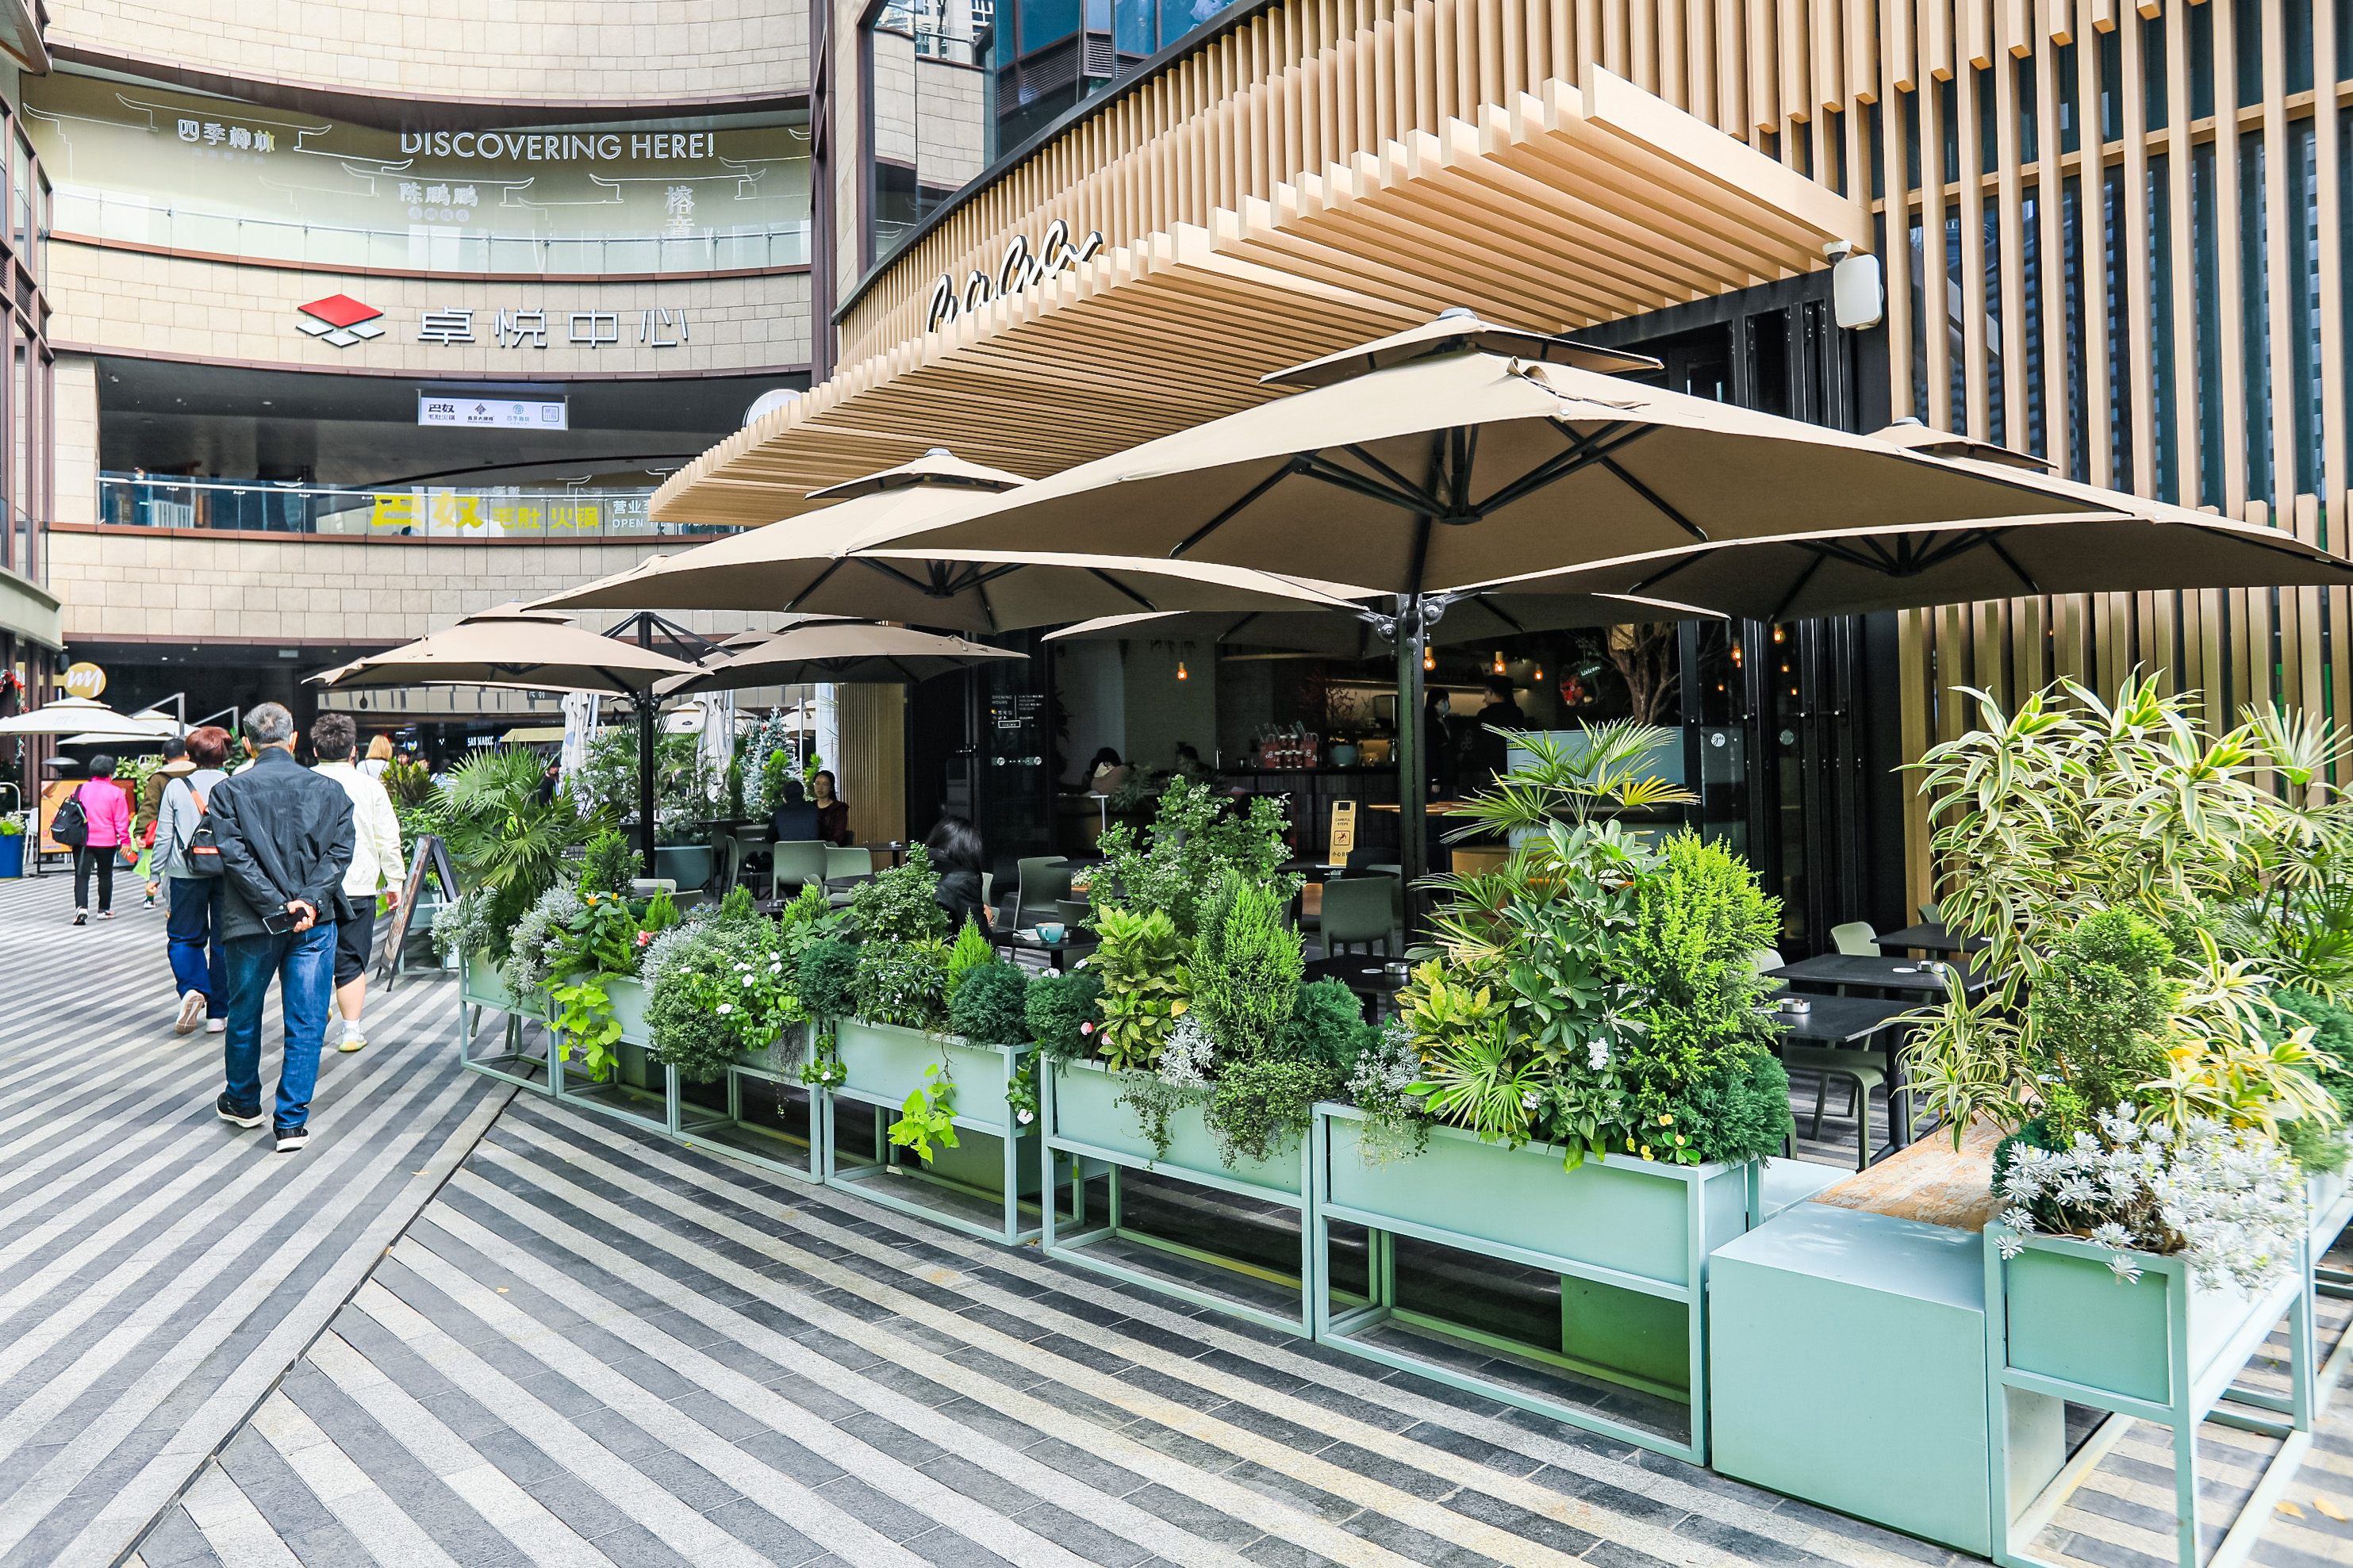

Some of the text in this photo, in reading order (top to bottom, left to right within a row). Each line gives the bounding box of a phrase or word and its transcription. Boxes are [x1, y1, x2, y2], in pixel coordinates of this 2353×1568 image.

[401, 132, 714, 160] DISCOVERING HERE!
[399, 182, 478, 207] 陈鹏鹏
[417, 305, 689, 348] 卓悦中心
[428, 403, 455, 413] 巴奴
[371, 490, 484, 528] 巴奴
[492, 507, 599, 529] 毛肚火锅
[612, 519, 643, 528] OPEN
